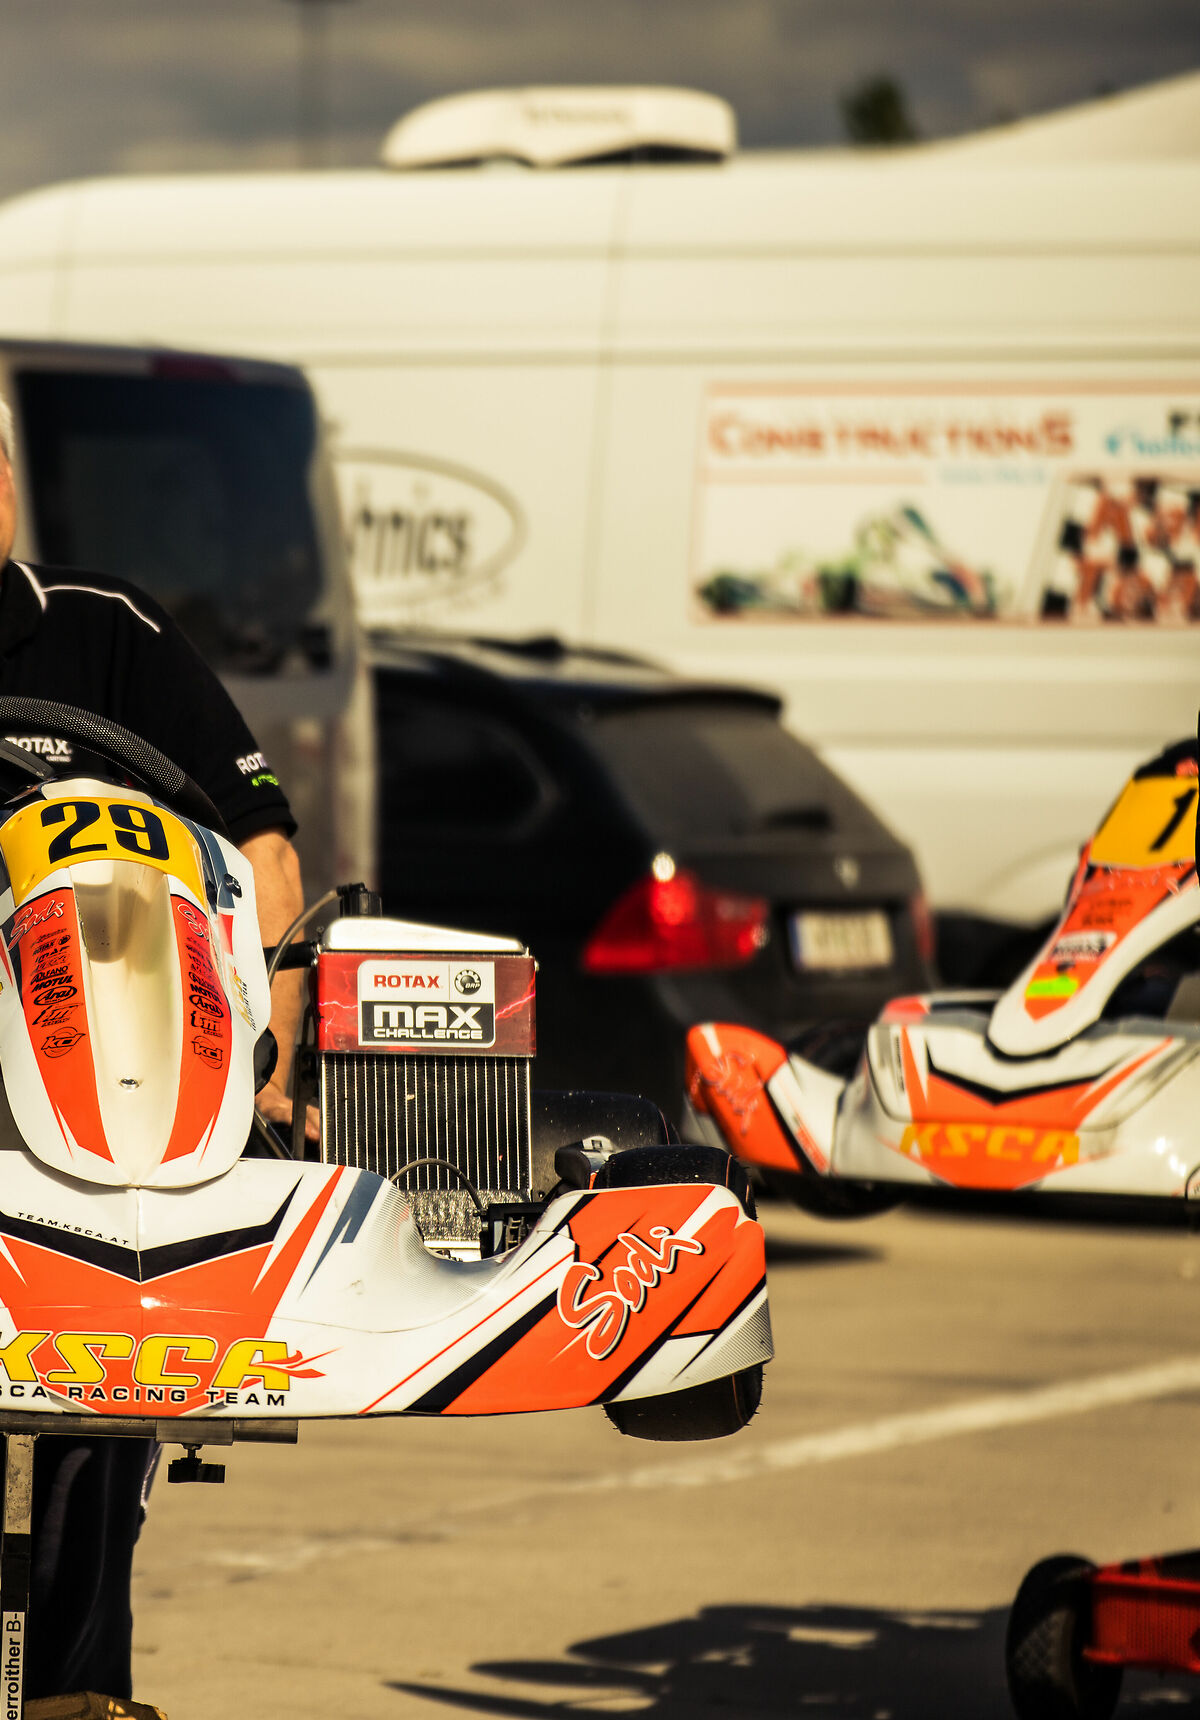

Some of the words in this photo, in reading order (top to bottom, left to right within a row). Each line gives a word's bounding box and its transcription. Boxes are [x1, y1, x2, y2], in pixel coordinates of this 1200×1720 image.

[40, 801, 169, 864] 29
[31, 974, 73, 994] MOTUL
[374, 974, 441, 989] ROTAX
[464, 981, 481, 990] BRP
[374, 1005, 482, 1029] MAX
[373, 1028, 483, 1040] CHALLENGE
[900, 1123, 1080, 1167] KSCA
[556, 1226, 704, 1360] Sodi
[68, 1387, 187, 1403] RACING
[206, 1390, 286, 1407] TEAM
